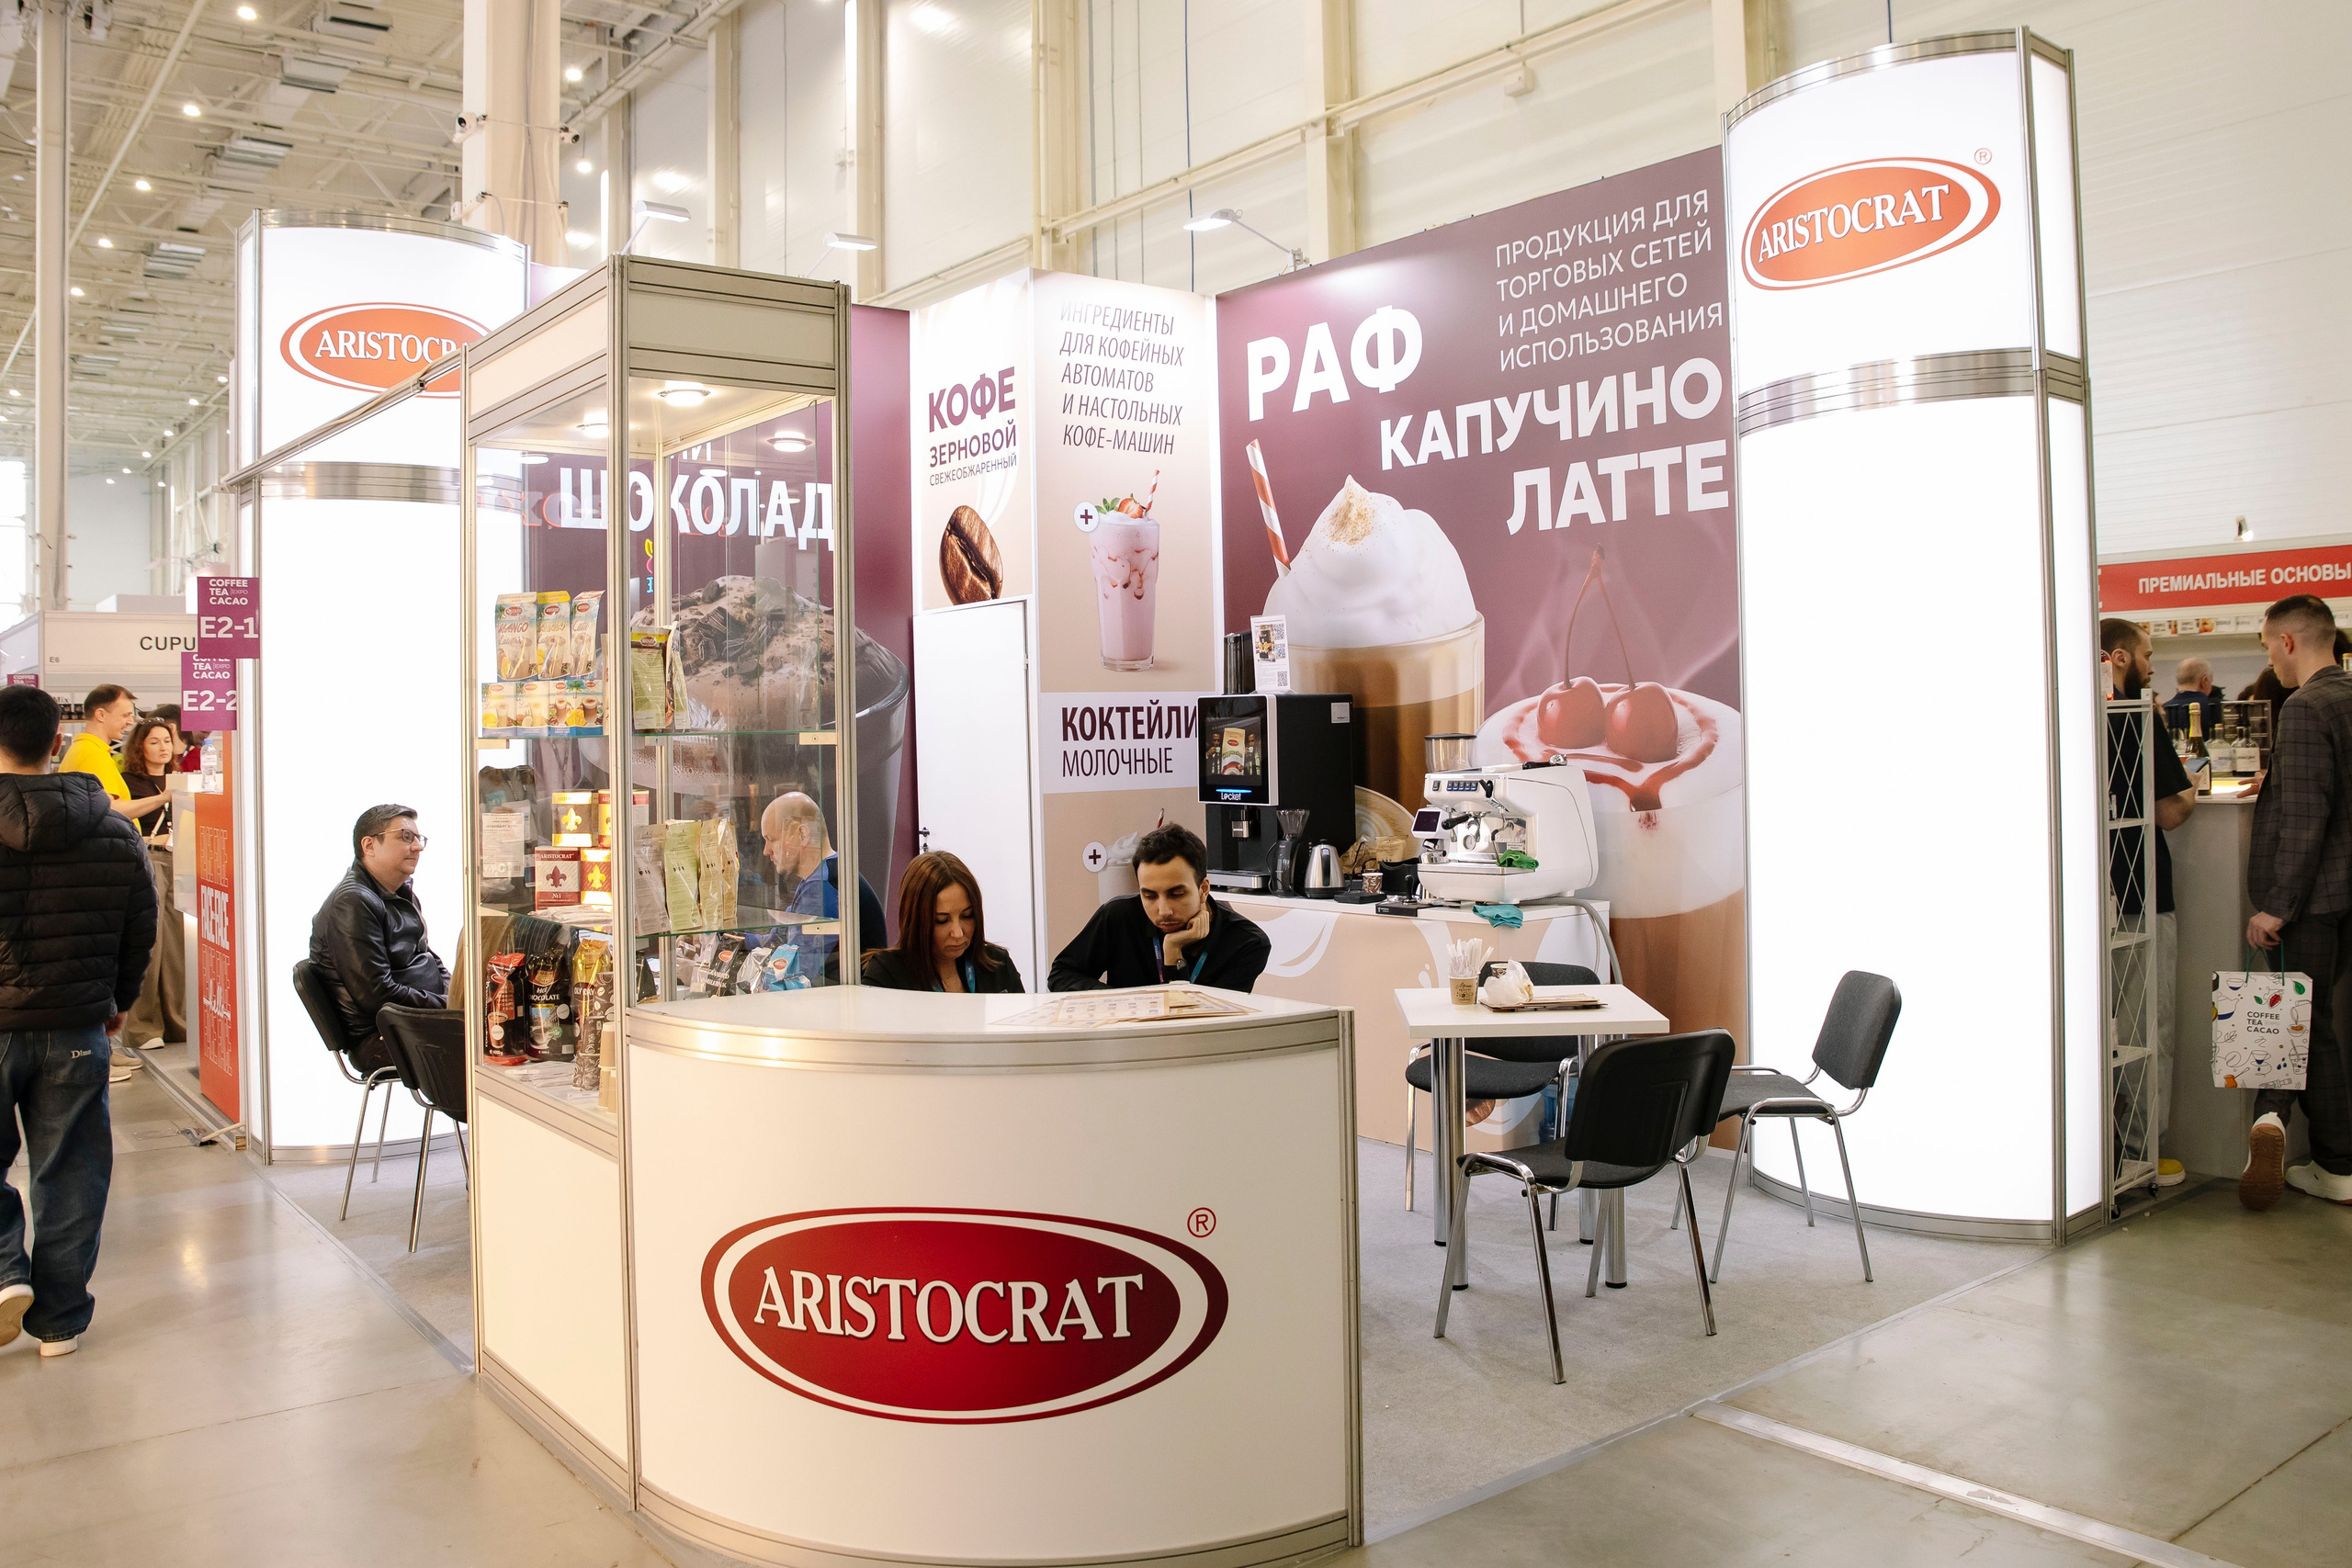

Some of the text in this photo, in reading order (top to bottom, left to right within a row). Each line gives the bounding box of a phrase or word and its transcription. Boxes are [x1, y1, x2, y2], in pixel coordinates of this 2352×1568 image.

[1495, 188, 1709, 267] ПРОДУКЦИЯ ДЛЯ
[1758, 184, 1950, 263] ARISTOCRAT
[1497, 221, 1713, 302] ТОРГОВЫХ СЕТЕЙ
[1060, 300, 1174, 335] ИНГРЕДИЕНТЫ
[1498, 272, 1688, 338] И ДОМАШНЕГО
[314, 330, 468, 362] ARISTOCR
[1059, 331, 1184, 367] ДЛЯ КОФЕЙНЫХ
[1499, 302, 1724, 372] ИСПОЛЬЗОВАНИЯ
[1061, 362, 1154, 393] АВТОМАТОВ
[1247, 304, 1423, 422] РАФ
[928, 366, 1016, 433] КОФЕ
[1062, 393, 1182, 426] И НАСТОЛЬНЫХ
[1380, 356, 1723, 471] КАПУЧИНО
[929, 419, 1017, 468] ЗЕРНОВОЙ
[1063, 424, 1175, 455] КОФЕ-МАШИН
[930, 451, 1017, 487] СВЕЖЕОБЖАРЕННЫЙ
[1506, 438, 1730, 536] ЛАТТЕ
[560, 464, 835, 551] ШОКОЛАД
[209, 579, 249, 588] COFFEE
[209, 588, 230, 596] TEA
[2138, 562, 2352, 594] ПРЕМИАЛЬНЫЕ ОСНОВЫ
[209, 597, 249, 605] CACAO
[140, 636, 196, 650] CUPU
[199, 616, 259, 638] E2-1
[192, 662, 212, 671] TEA
[192, 671, 231, 680] CACAO
[183, 690, 237, 711] E2-2
[1061, 699, 1198, 741] КОКТЕЙЛИ
[1062, 747, 1173, 778] МОЛОЧНЫЕ
[2246, 1026, 2279, 1034] CACAO
[2247, 1011, 2280, 1020] COFFEE
[753, 1266, 1143, 1344] ARISTOCRAT
